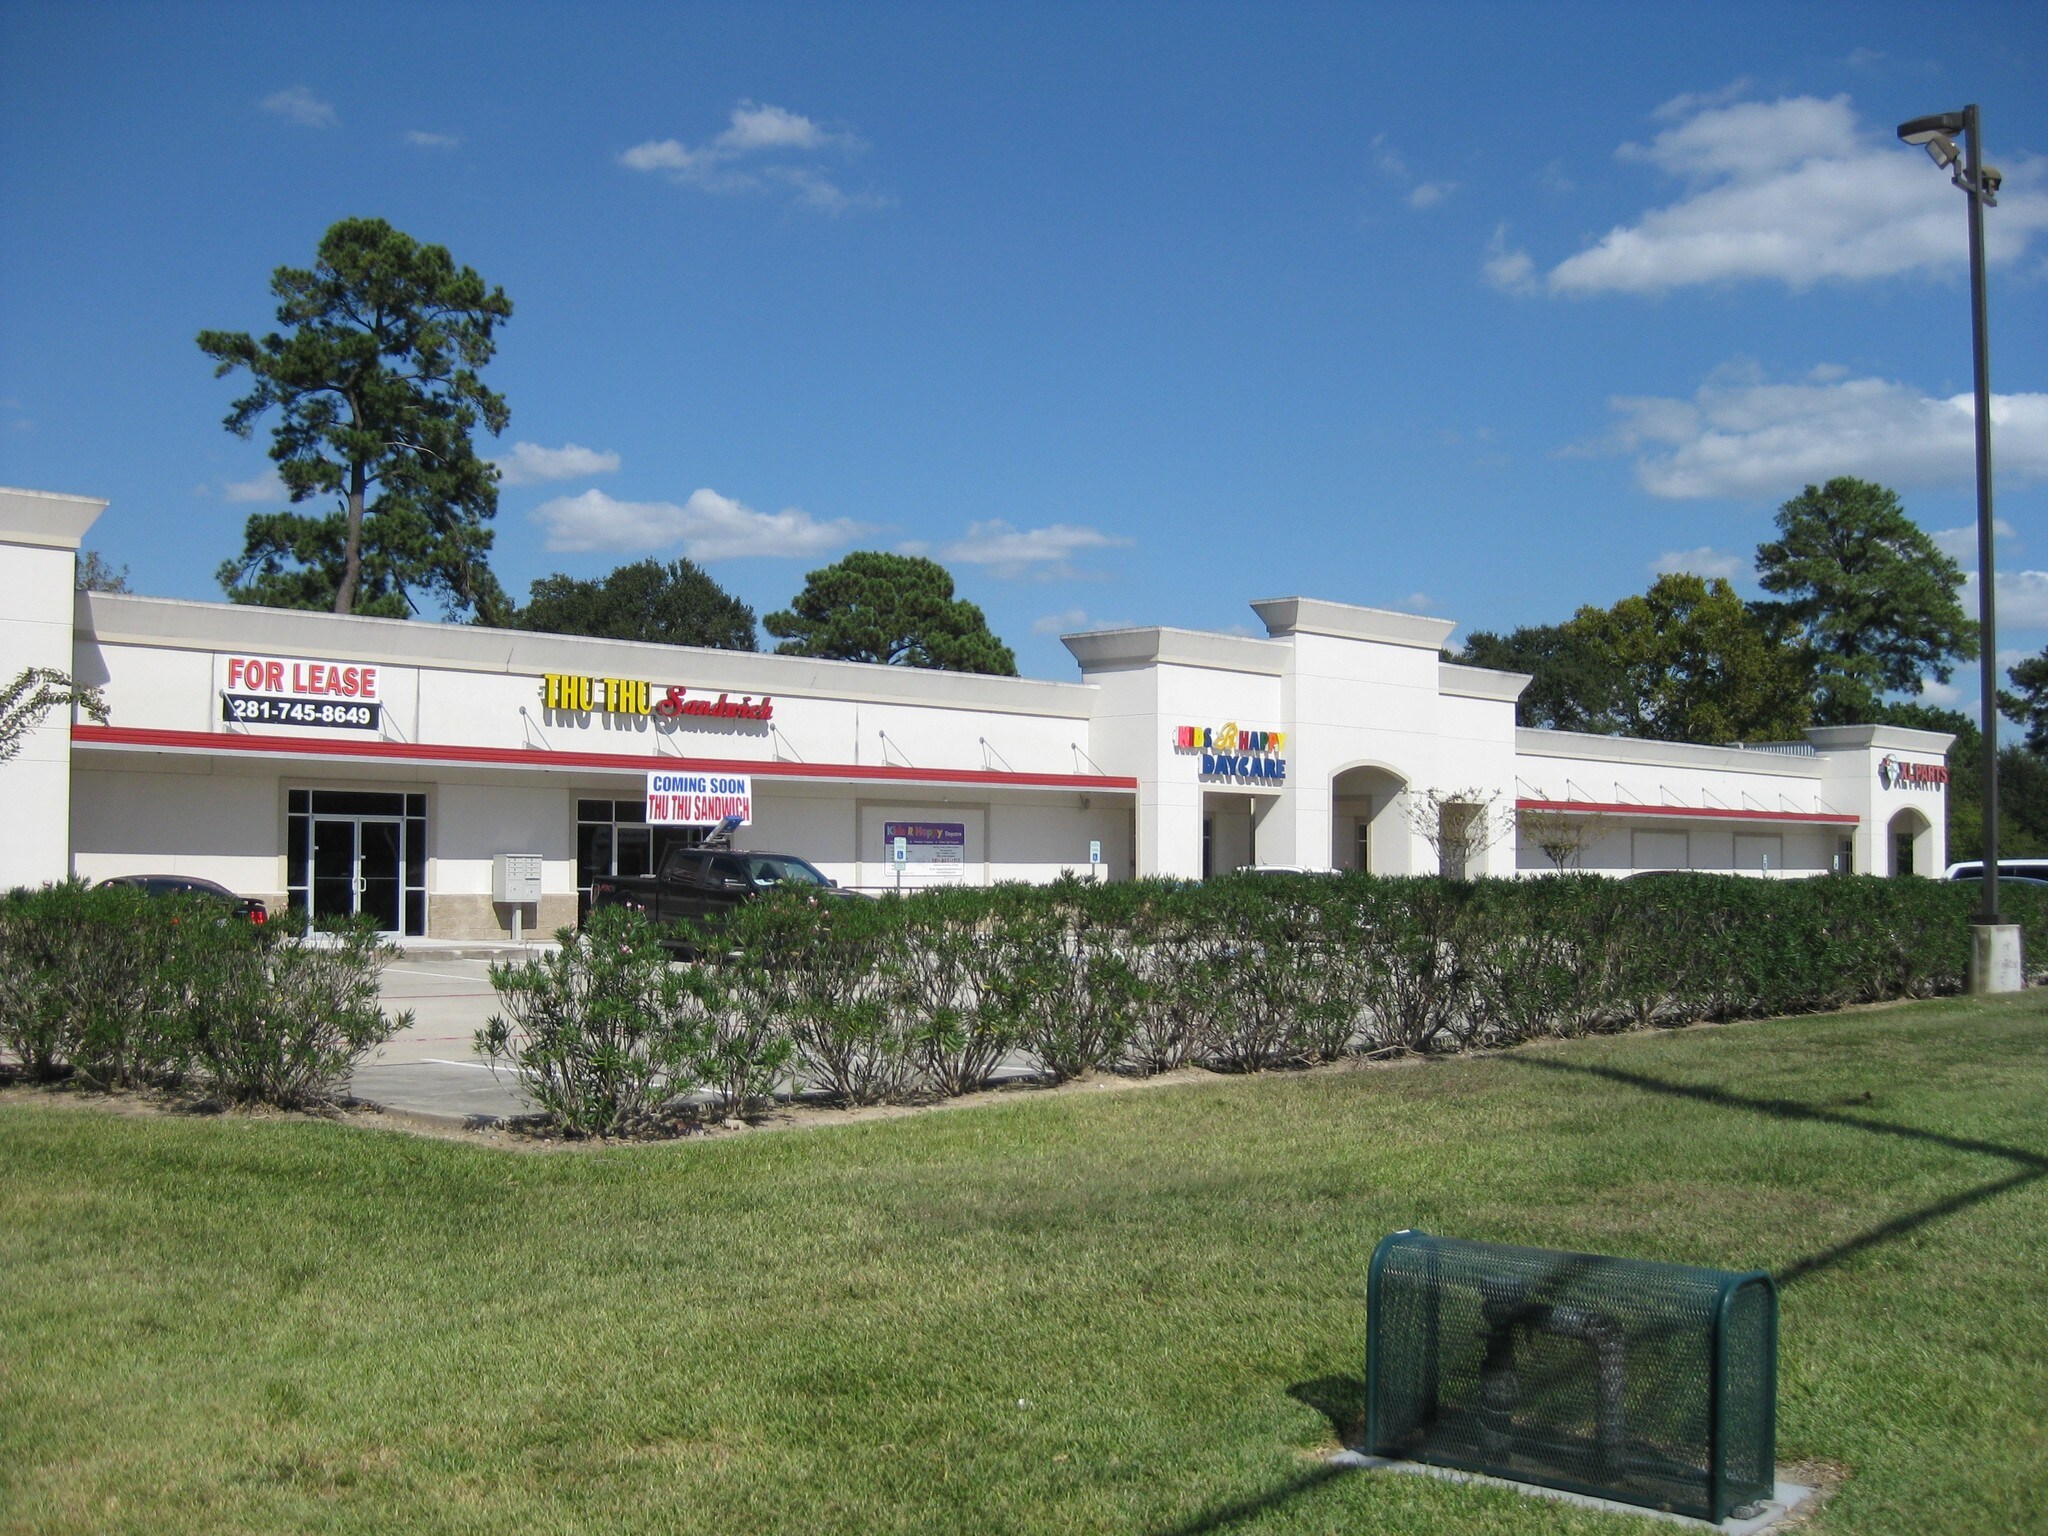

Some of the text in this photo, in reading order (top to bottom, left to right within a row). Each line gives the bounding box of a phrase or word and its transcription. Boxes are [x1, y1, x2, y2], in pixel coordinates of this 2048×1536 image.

[228, 658, 376, 697] FOR LEASE
[543, 673, 774, 721] THU THU Sandwich
[233, 700, 371, 724] 281-745-8649
[1239, 730, 1287, 752] HAPPY
[1202, 754, 1286, 779] DAYCARE
[1898, 762, 1950, 783] XL PARTS
[652, 775, 745, 794] COMING SOON
[649, 794, 750, 822] THU THU SANDWICH
